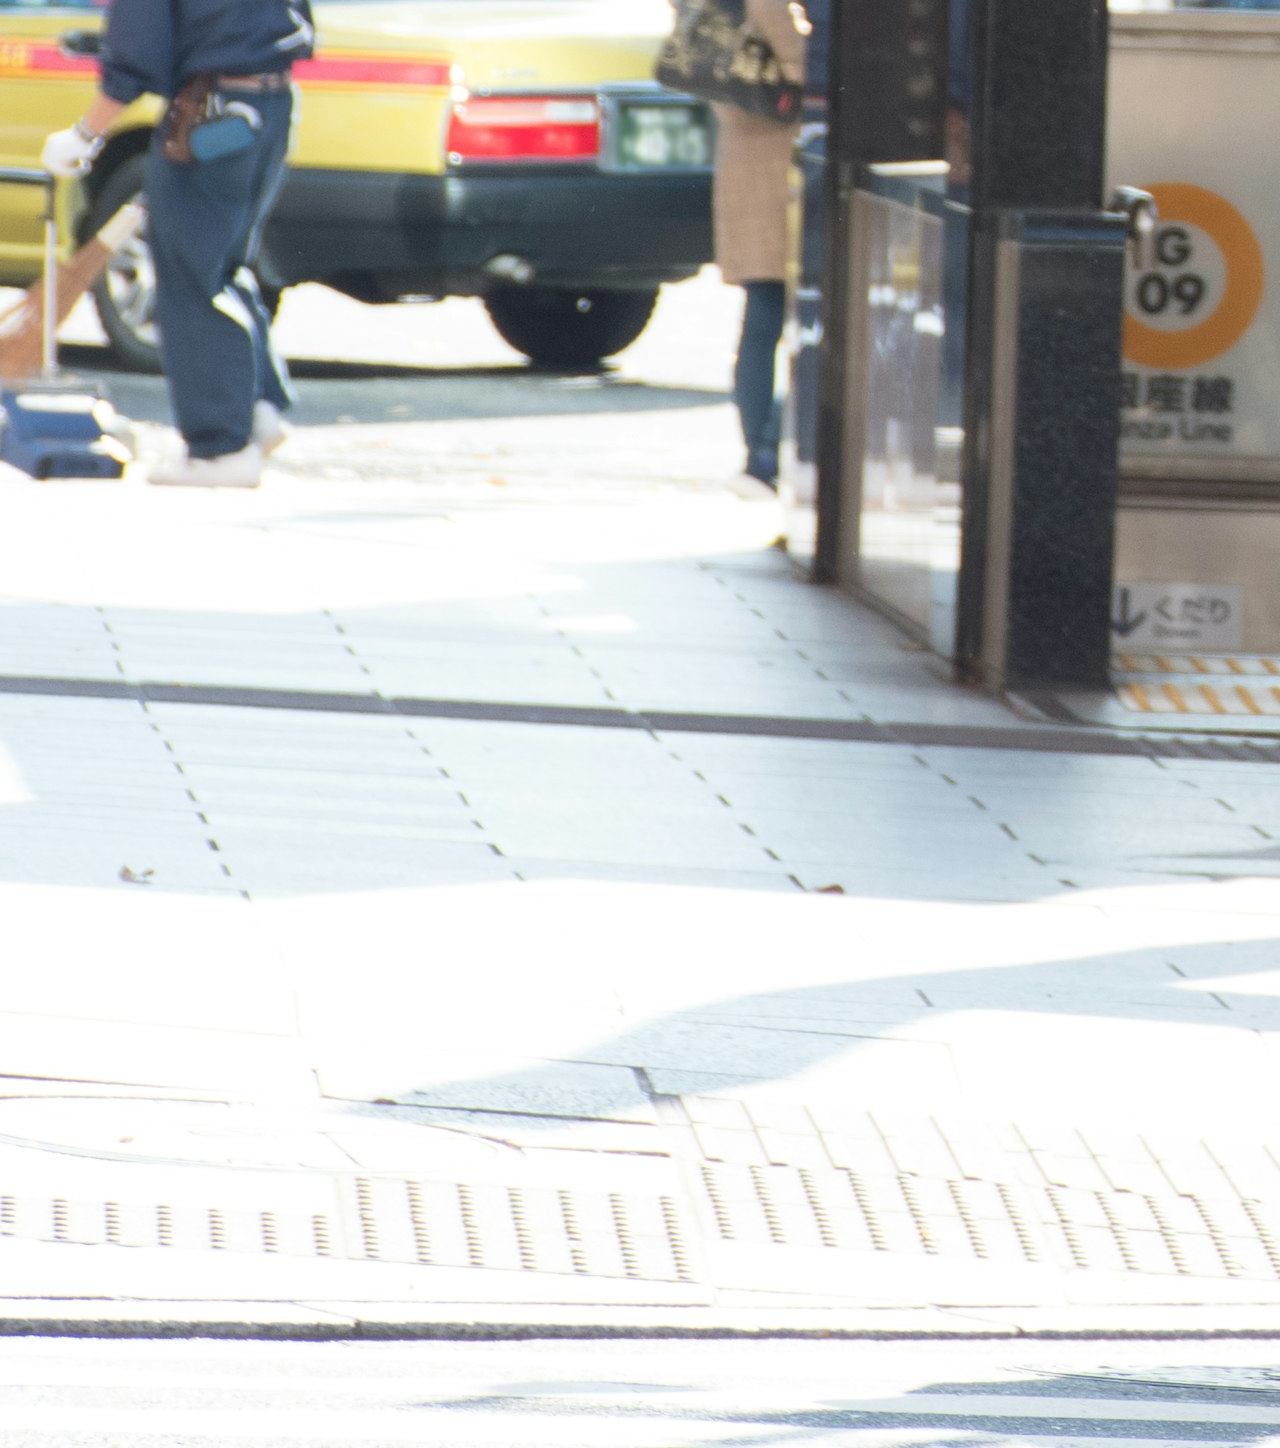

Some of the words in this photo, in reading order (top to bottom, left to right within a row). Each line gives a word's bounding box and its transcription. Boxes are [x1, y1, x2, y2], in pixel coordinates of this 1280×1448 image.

[1155, 226, 1193, 266] G
[1136, 272, 1206, 315] 09
[1155, 594, 1232, 626] くだり
